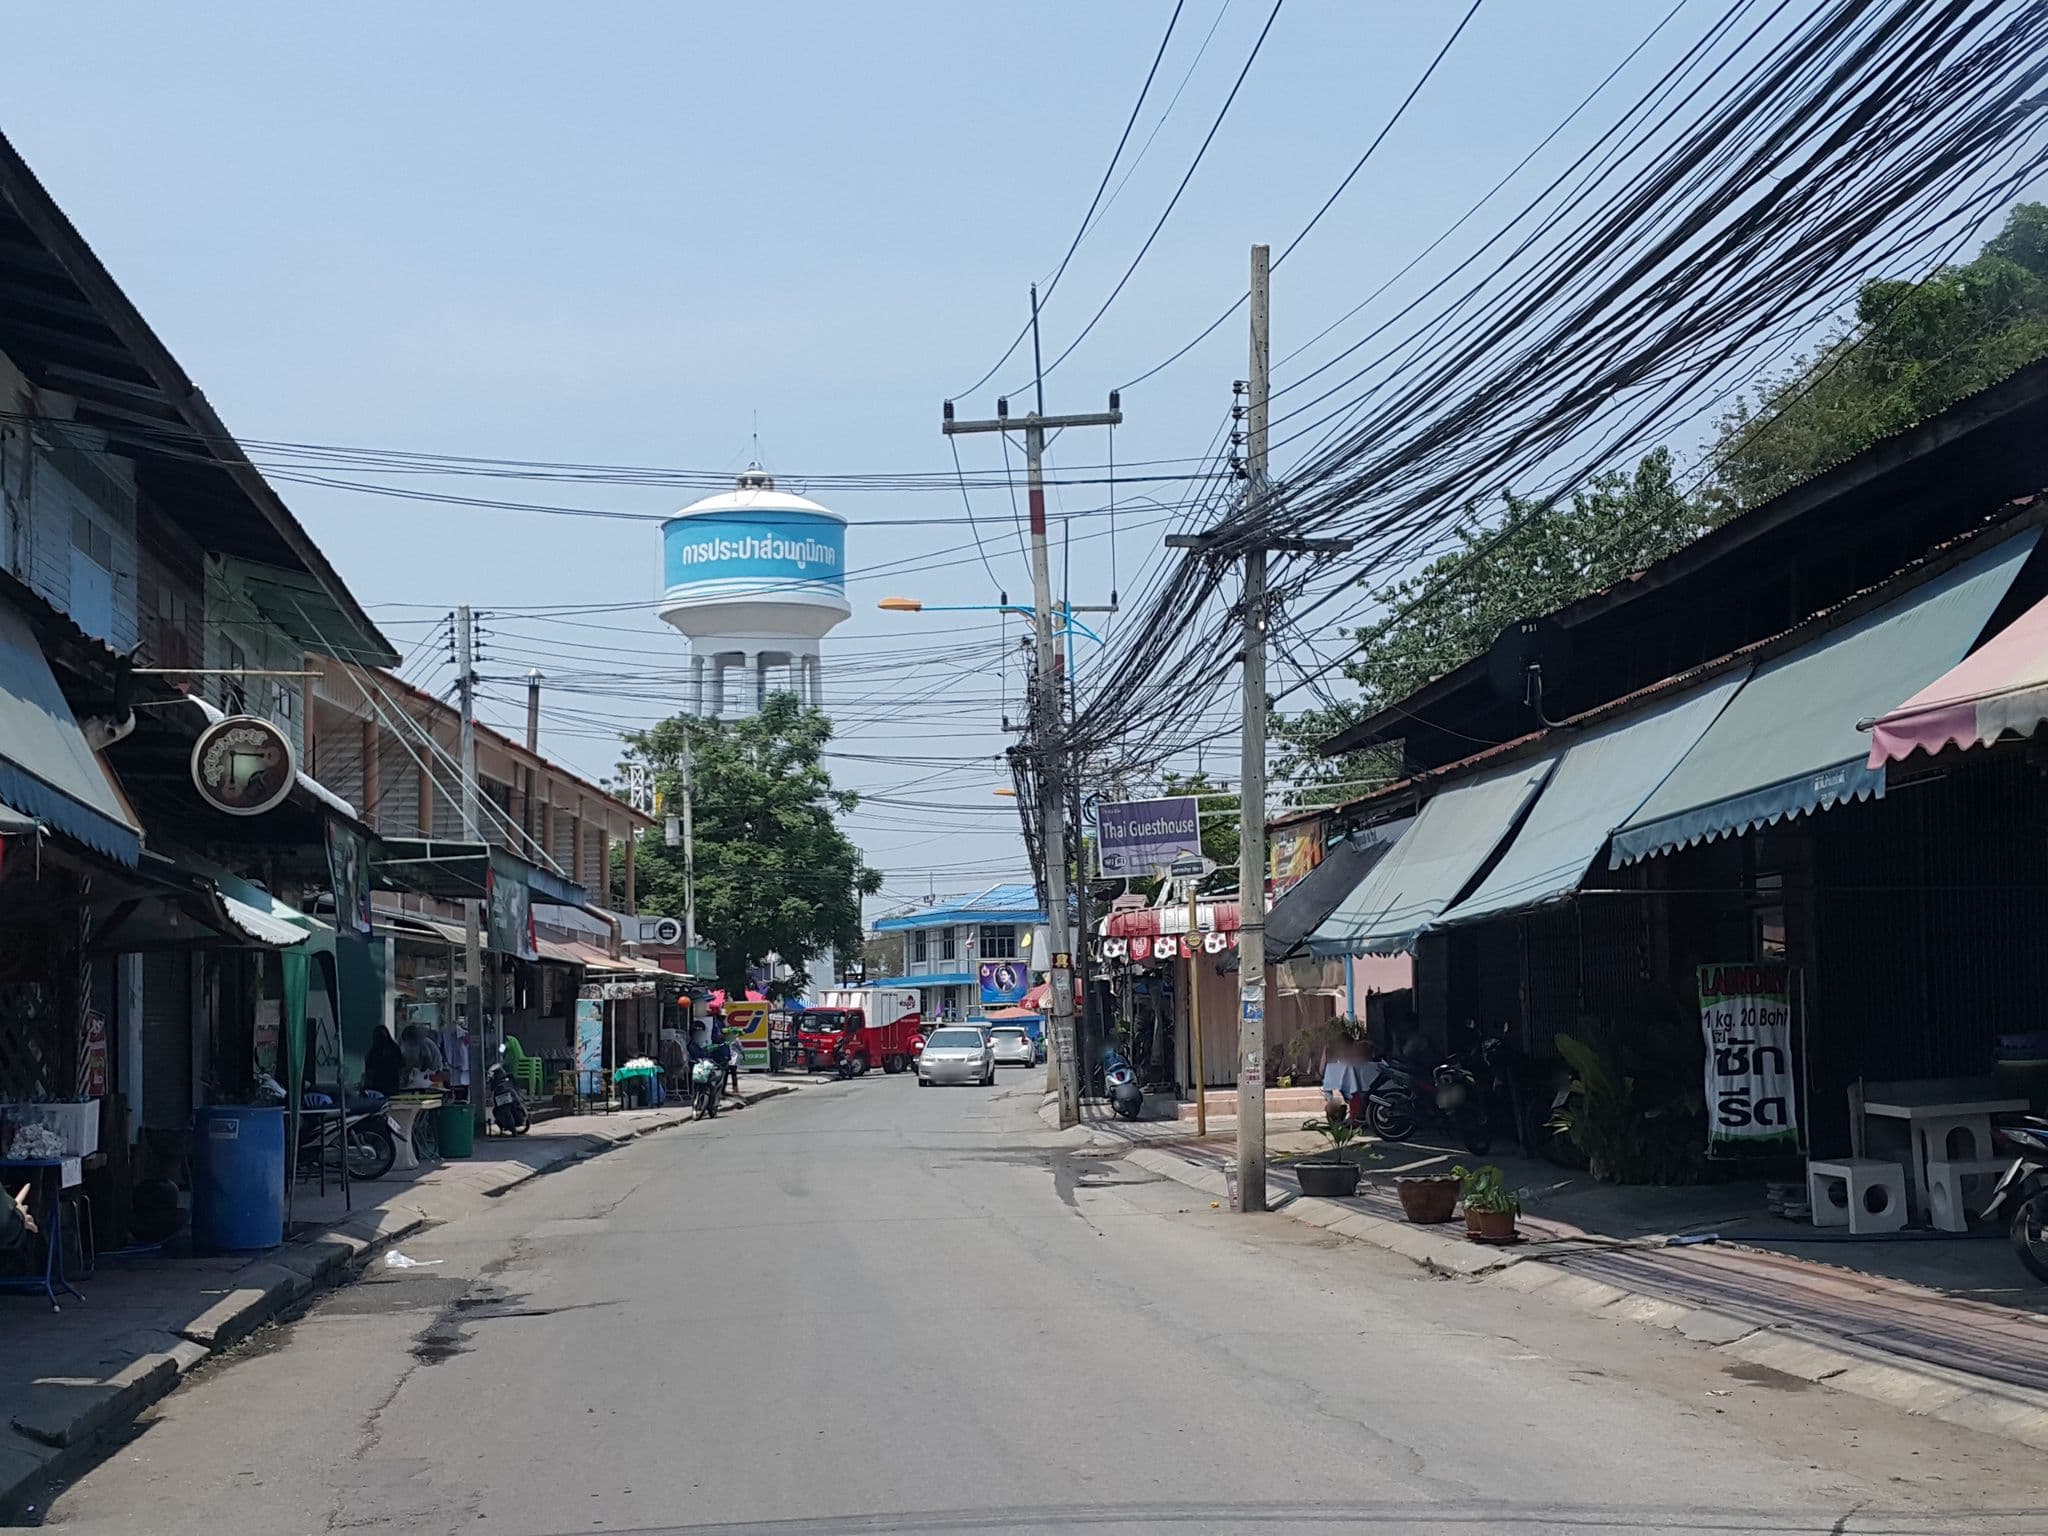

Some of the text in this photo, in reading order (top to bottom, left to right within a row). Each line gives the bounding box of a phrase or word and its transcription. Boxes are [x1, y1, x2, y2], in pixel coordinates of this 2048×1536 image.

[683, 533, 836, 569] การประปาส่วนภูมิภาค
[1102, 817, 1195, 839] Thai Guesthouse
[1702, 967, 1789, 996] LAUNDRY
[1704, 1008, 1788, 1031] 1 kg. 20 Baht
[1715, 1037, 1785, 1076] ซัก
[1718, 1087, 1787, 1127] รีด
